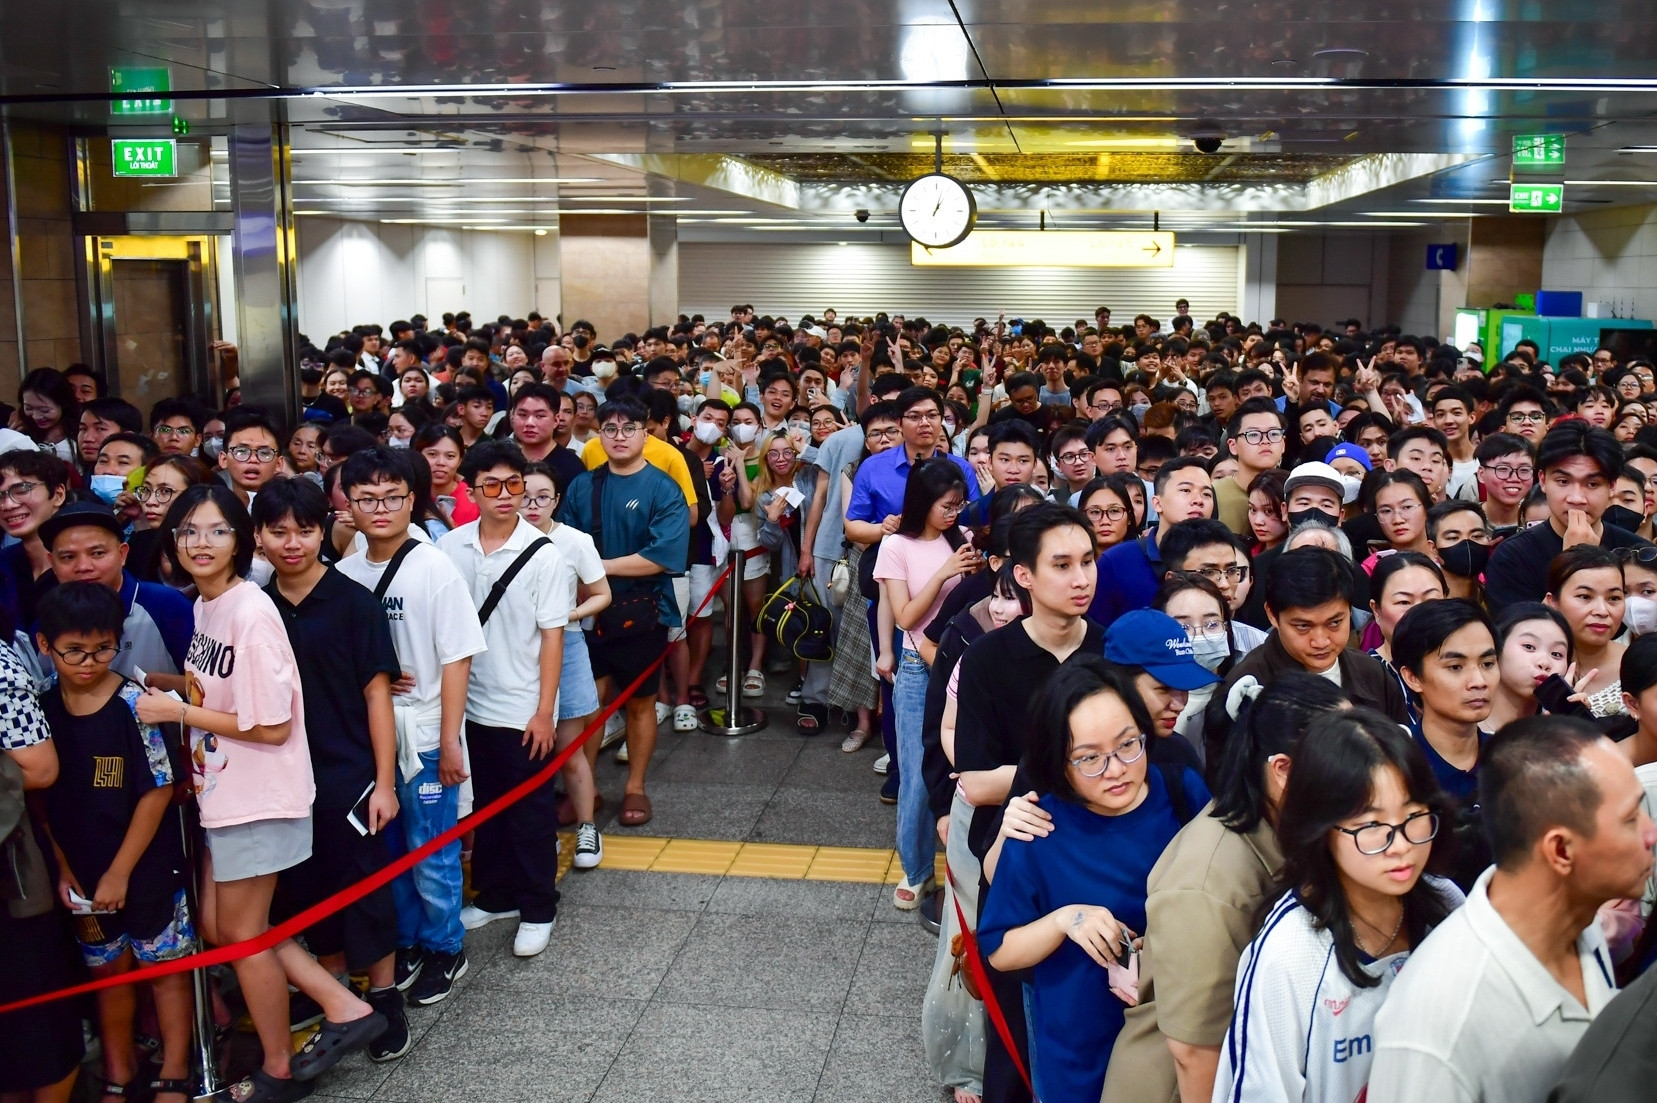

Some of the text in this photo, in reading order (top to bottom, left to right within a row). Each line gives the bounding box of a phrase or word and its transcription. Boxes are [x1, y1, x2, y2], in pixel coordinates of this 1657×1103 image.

[123, 146, 164, 162] EXIT
[388, 612, 404, 621] ACE
[1333, 1034, 1372, 1063] Em
